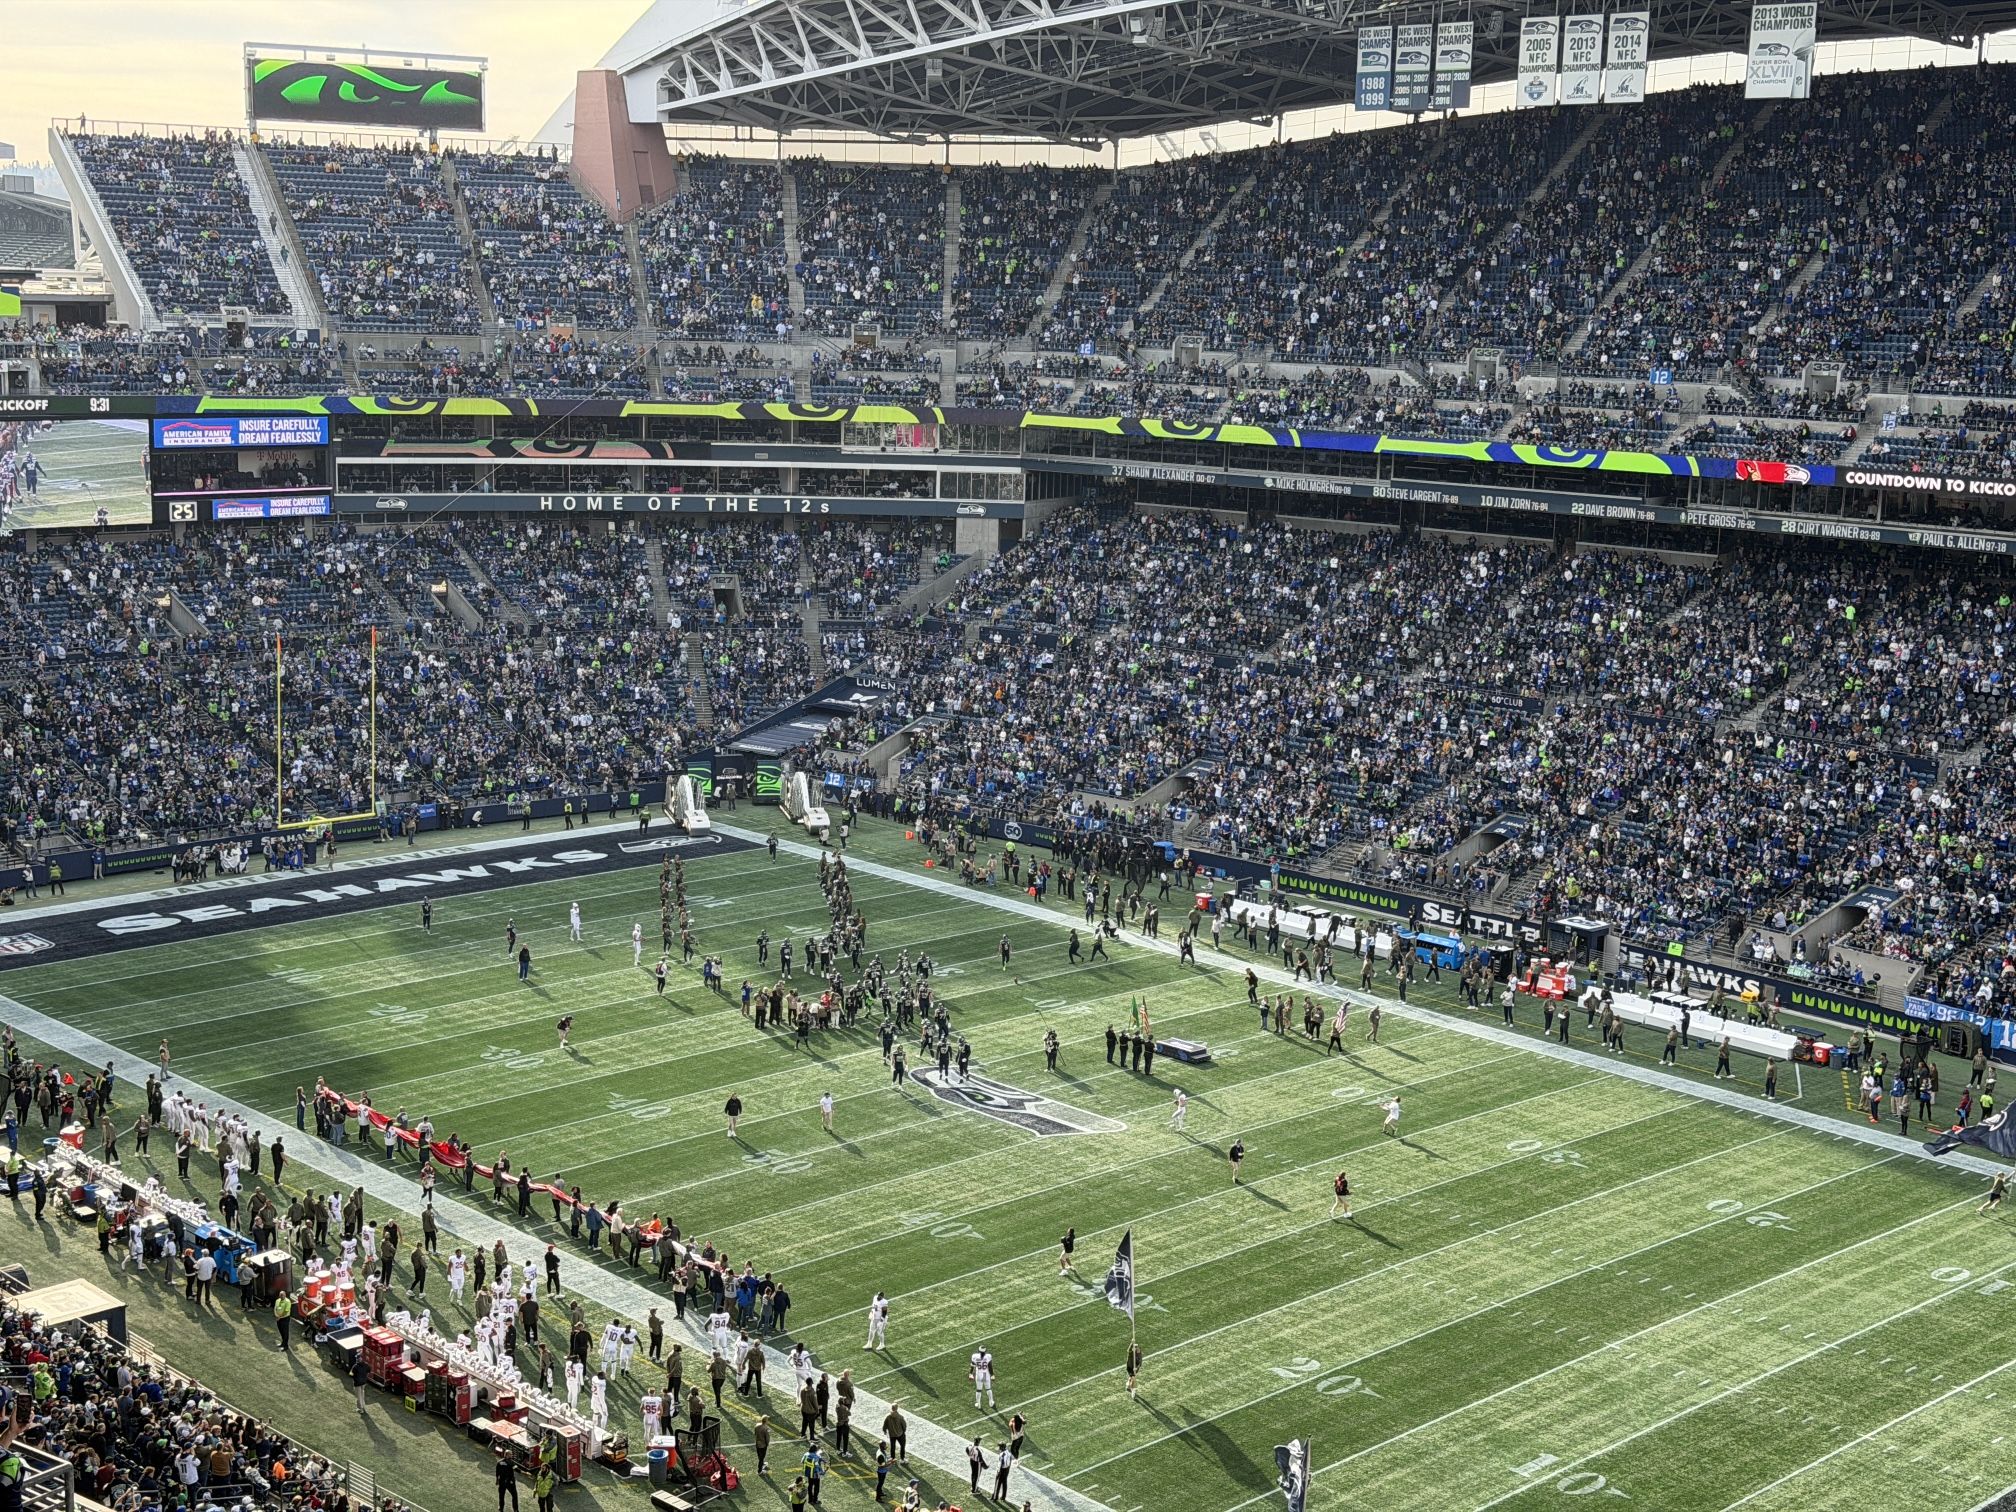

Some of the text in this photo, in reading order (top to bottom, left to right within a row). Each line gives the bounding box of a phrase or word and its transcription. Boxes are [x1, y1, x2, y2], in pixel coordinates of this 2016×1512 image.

[1754, 6, 1814, 19] 2013 WORLD
[1439, 25, 1472, 34] NFC WEST
[1754, 18, 1813, 31] CHAMPIONS
[1373, 29, 1391, 37] WEST
[1399, 26, 1432, 36] NFC WEST
[1359, 38, 1390, 50] CHAMPS
[1398, 36, 1430, 47] CHAMPS
[1438, 34, 1472, 46] CHAMPS
[1526, 38, 1552, 51] 2005
[1569, 37, 1596, 50] 2013
[1614, 34, 1641, 48] 2014
[1528, 52, 1547, 63] NFC
[1572, 51, 1591, 62] NFC
[1617, 49, 1636, 60] NFC
[1520, 64, 1555, 73] CHAMPIONS
[1562, 63, 1600, 72] CHAMPIONS
[1607, 61, 1645, 70] CHAMPIONS
[1749, 66, 1793, 79] XLVIII
[1362, 77, 1384, 90] 1988
[1361, 93, 1384, 105] 1999
[1080, 343, 1090, 354] 12
[1814, 363, 1840, 371] 334
[1655, 370, 1668, 383] 12
[90, 398, 110, 412] 9:31
[239, 420, 320, 431] INSURE CAREFULLY,
[1882, 421, 1895, 430] 12
[239, 431, 321, 444] DREAM FEARLESSLY
[267, 450, 296, 461] Mobile
[1112, 466, 1216, 484] 37 SHAUN ALEXANDER 00-07
[1276, 479, 1295, 489] MIKE
[1296, 480, 1335, 494] HOLMGREN
[1846, 471, 2016, 496] COUNTDOWN TO KICKO
[1373, 487, 1385, 497] 80
[1387, 488, 1408, 500] STEVE
[1409, 490, 1441, 503] LARGENT
[270, 499, 289, 507] INSURE
[540, 496, 830, 513] HOME OF THE 12s
[1481, 495, 1493, 506] 10
[1494, 497, 1509, 508] JIM
[1510, 498, 1530, 510] ZORN
[173, 504, 193, 520] 25
[292, 506, 326, 515] FEARLESSLY
[1572, 503, 1655, 520] 22 DAVE BROWN 76-86
[1687, 512, 1755, 530] PETE GROSS 76-92
[1781, 521, 1880, 540] 28 CURT WARNER 83-89
[1923, 535, 2006, 552] PAUL G. ALLEN 97-18
[856, 678, 896, 690] LUMEN
[1504, 697, 1523, 707] CLUB
[829, 773, 840, 786] 12
[1006, 825, 1019, 836] 50
[150, 872, 281, 896] SALUTE
[344, 846, 478, 868] SERVICE
[96, 849, 609, 935] SEAHAWKS
[1908, 1003, 1926, 1012] PAUL
[1905, 1009, 1928, 1020] ALLEN
[480, 1048, 546, 1069] 30
[77, 1134, 83, 1144] G
[1506, 1140, 1580, 1163] 30
[1706, 1200, 1790, 1227] 20
[726, 1283, 734, 1292] 21
[1930, 1267, 2015, 1296] 10
[301, 1301, 309, 1313] G
[503, 1305, 514, 1314] 30
[714, 1320, 726, 1329] 94
[608, 1332, 617, 1341] 10
[976, 1361, 987, 1370] 56
[1268, 1357, 1362, 1395] 20
[180, 1463, 187, 1473] 11
[1510, 1453, 1606, 1495] 10
